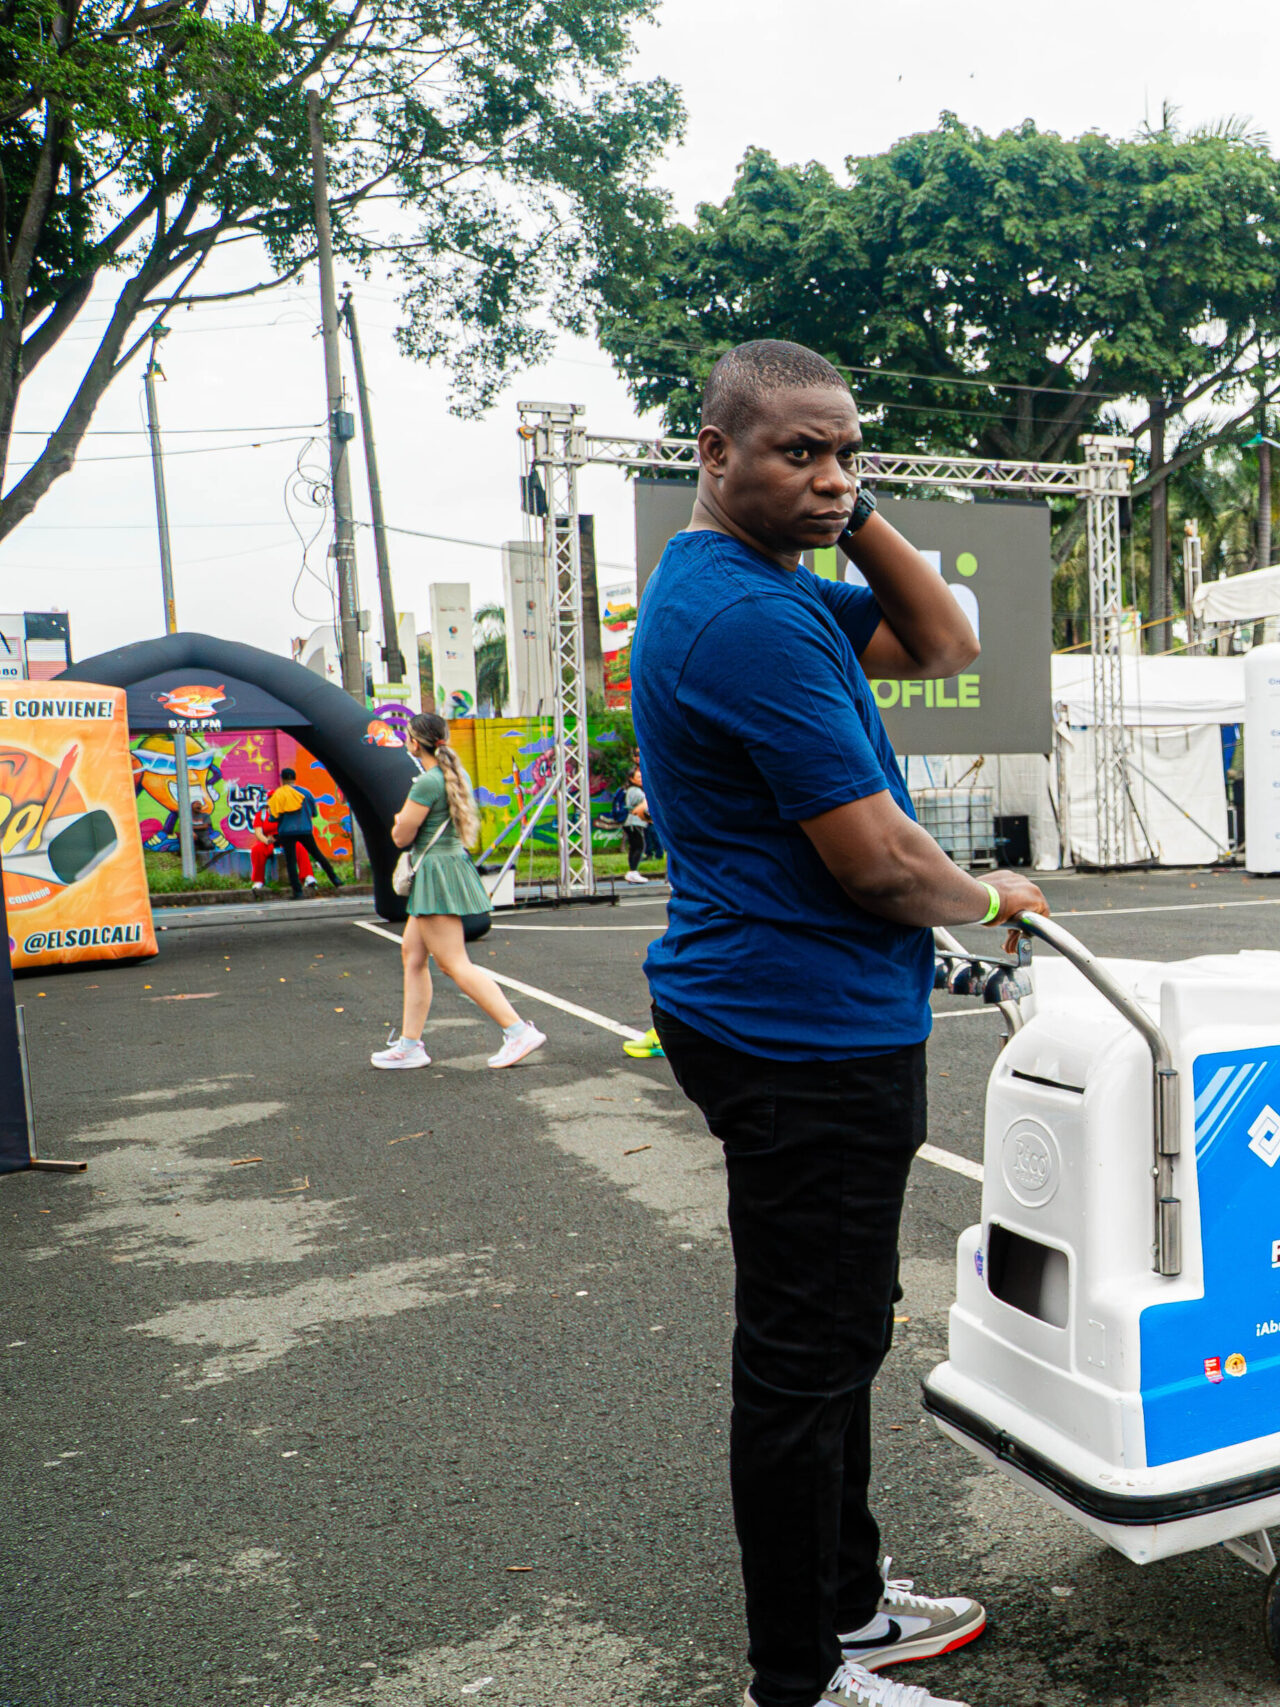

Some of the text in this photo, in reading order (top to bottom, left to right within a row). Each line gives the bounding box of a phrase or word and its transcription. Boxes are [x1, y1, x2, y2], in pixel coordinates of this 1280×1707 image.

[870, 674, 981, 709] OFILE
[14, 700, 113, 718] CONVIENE!
[168, 719, 222, 729] 97.5 FM
[23, 924, 142, 954] @ELSOLCALI
